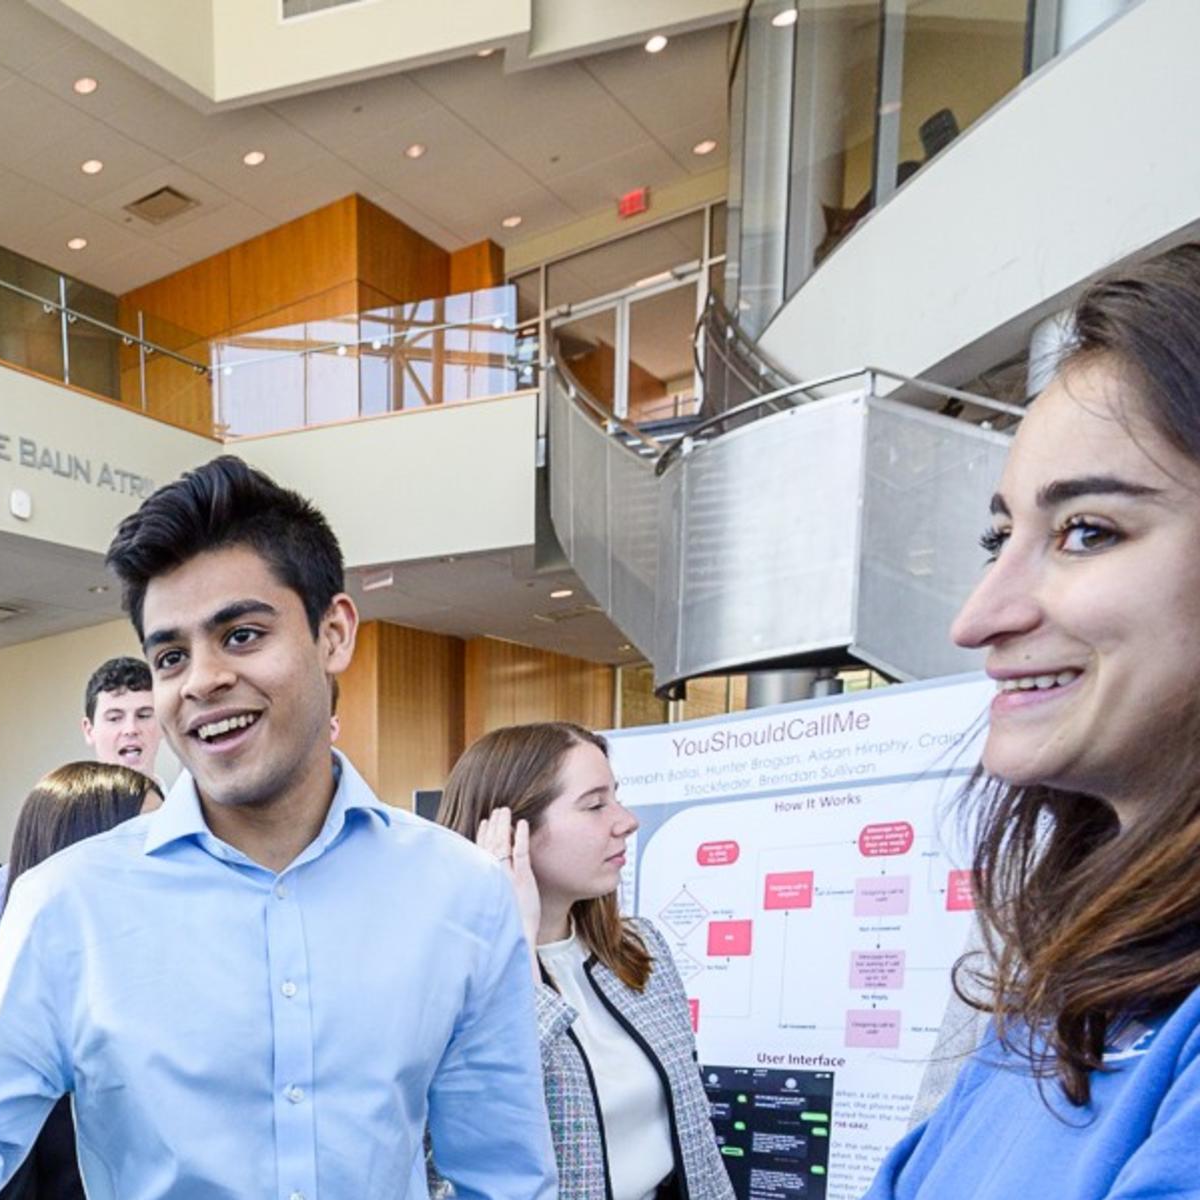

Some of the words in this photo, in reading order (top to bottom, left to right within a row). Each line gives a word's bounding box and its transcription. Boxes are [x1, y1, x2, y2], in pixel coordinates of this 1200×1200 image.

[19, 436, 91, 484] BAUN
[96, 462, 153, 499] ATRI
[672, 709, 871, 757] YouShouldCallMe
[706, 761, 748, 775] Hunter
[808, 748, 850, 762] Aidan
[759, 772, 817, 787] Brendan
[821, 762, 876, 778] Sullivan
[774, 802, 801, 813] How
[806, 799, 815, 809] It
[820, 794, 861, 808] Works
[757, 1053, 785, 1064] User
[789, 1053, 846, 1066] Interface
